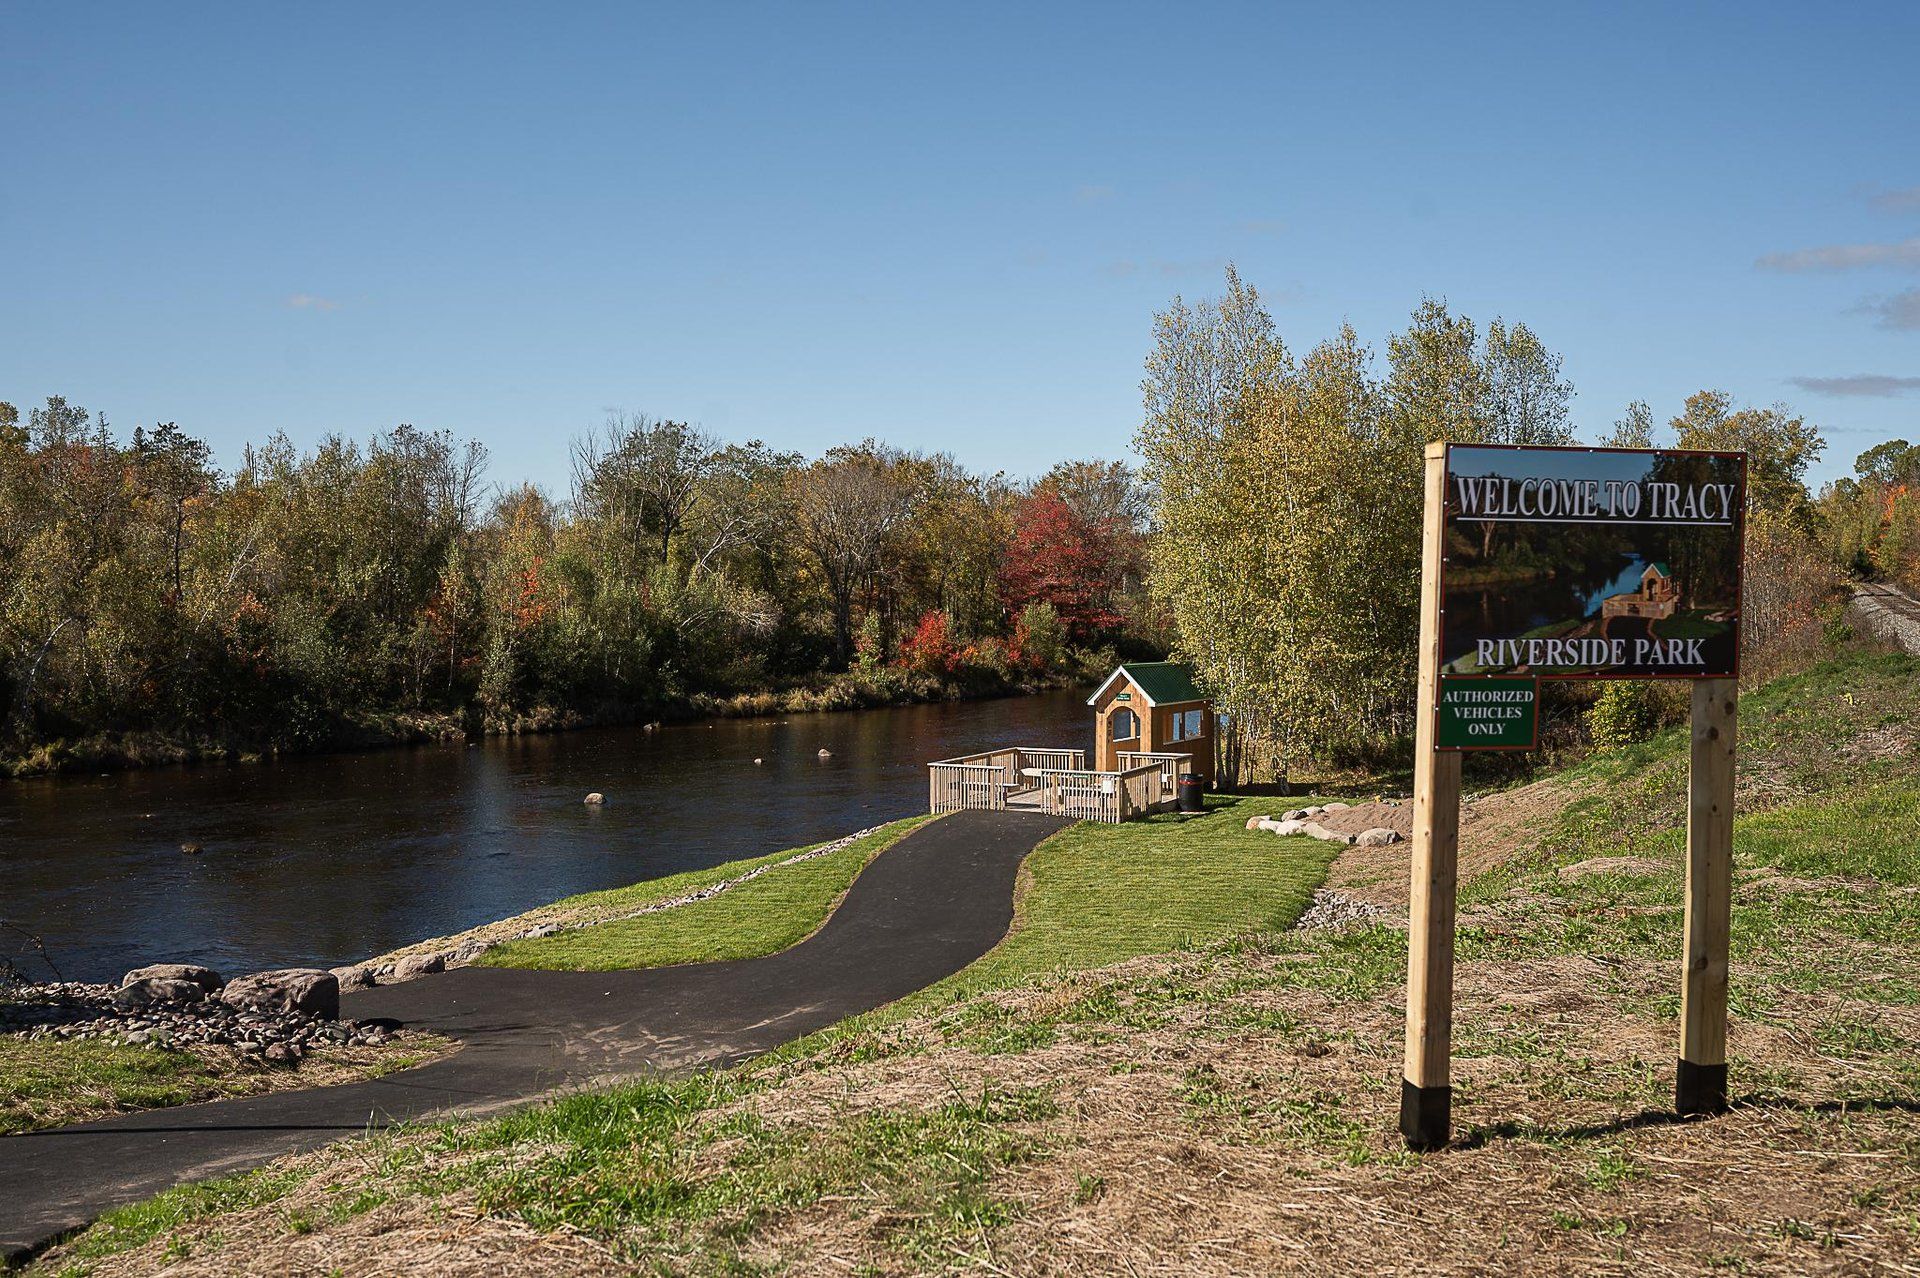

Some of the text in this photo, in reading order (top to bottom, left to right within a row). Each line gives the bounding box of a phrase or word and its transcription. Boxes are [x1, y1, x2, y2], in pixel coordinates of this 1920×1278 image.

[1456, 477, 1736, 520] WELCOME TO TRACY
[1476, 638, 1706, 666] RIVERSIDE PARK
[1443, 690, 1534, 702] AUTHORIZED
[1454, 706, 1522, 719] VEHICLES
[1468, 723, 1506, 735] ONLY
